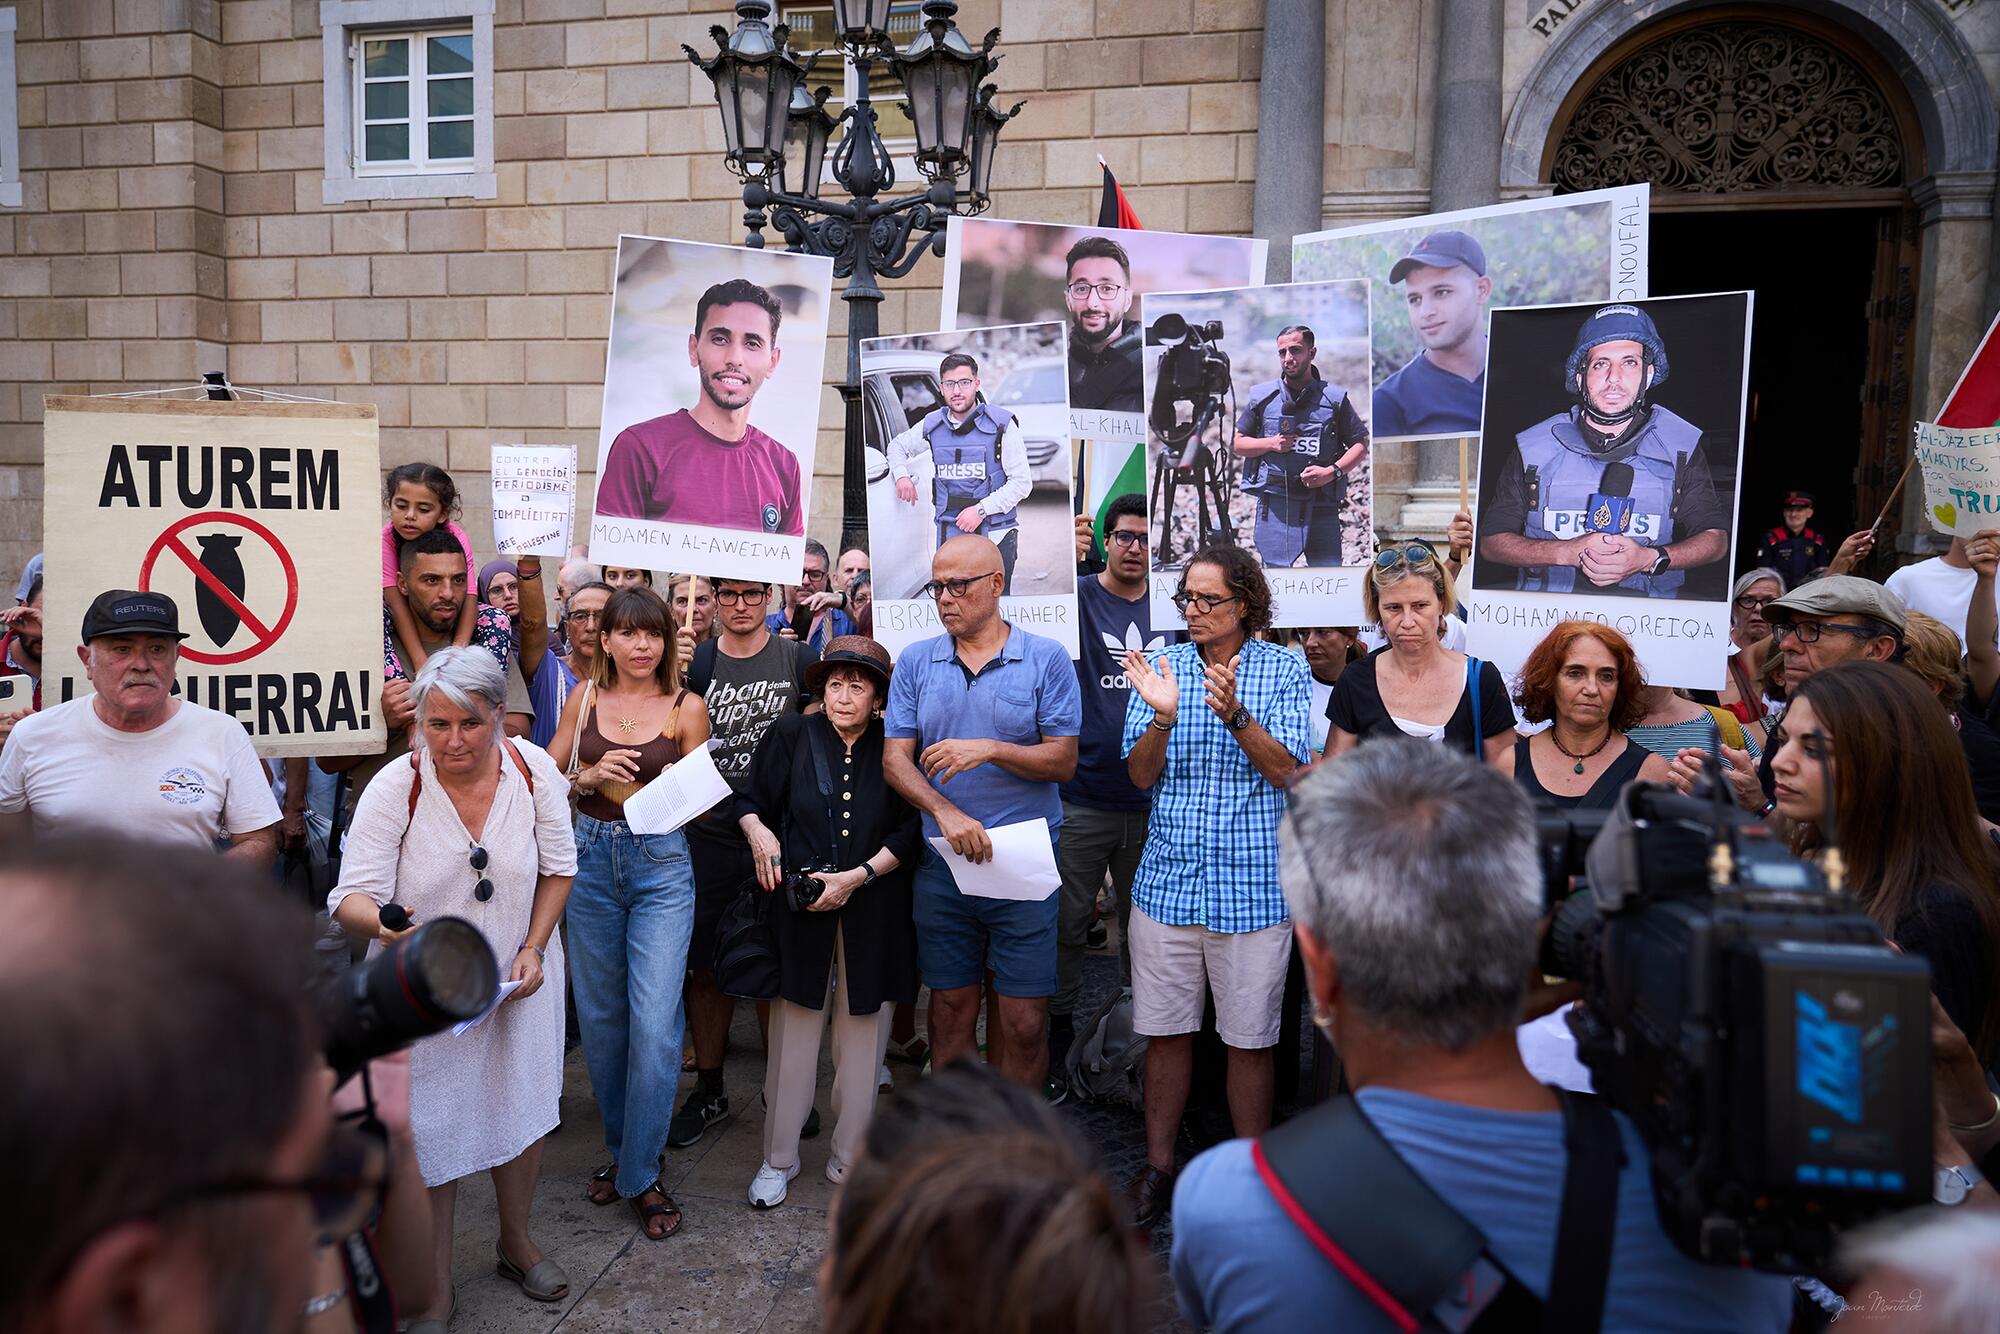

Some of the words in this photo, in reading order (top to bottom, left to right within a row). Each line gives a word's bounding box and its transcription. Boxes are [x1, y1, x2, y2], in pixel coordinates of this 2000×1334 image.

[1069, 413, 1145, 436] AL-KHAL
[496, 455, 550, 465] CONTRA
[98, 444, 341, 511] ATUREM
[495, 468, 508, 476] EL
[939, 463, 984, 477] PRESS
[1924, 466, 1945, 481] FOR
[1927, 483, 1946, 496] THE
[498, 537, 517, 552] FREE
[516, 530, 561, 554] PALESTINE
[592, 523, 672, 547] MOAMEN
[681, 534, 791, 561] AL-AWEIWA
[115, 604, 167, 616] REUTERS
[874, 602, 941, 633] IBRA
[1615, 614, 1715, 641] QREIQA
[767, 679, 792, 690] denim
[171, 670, 371, 736] UERRA!
